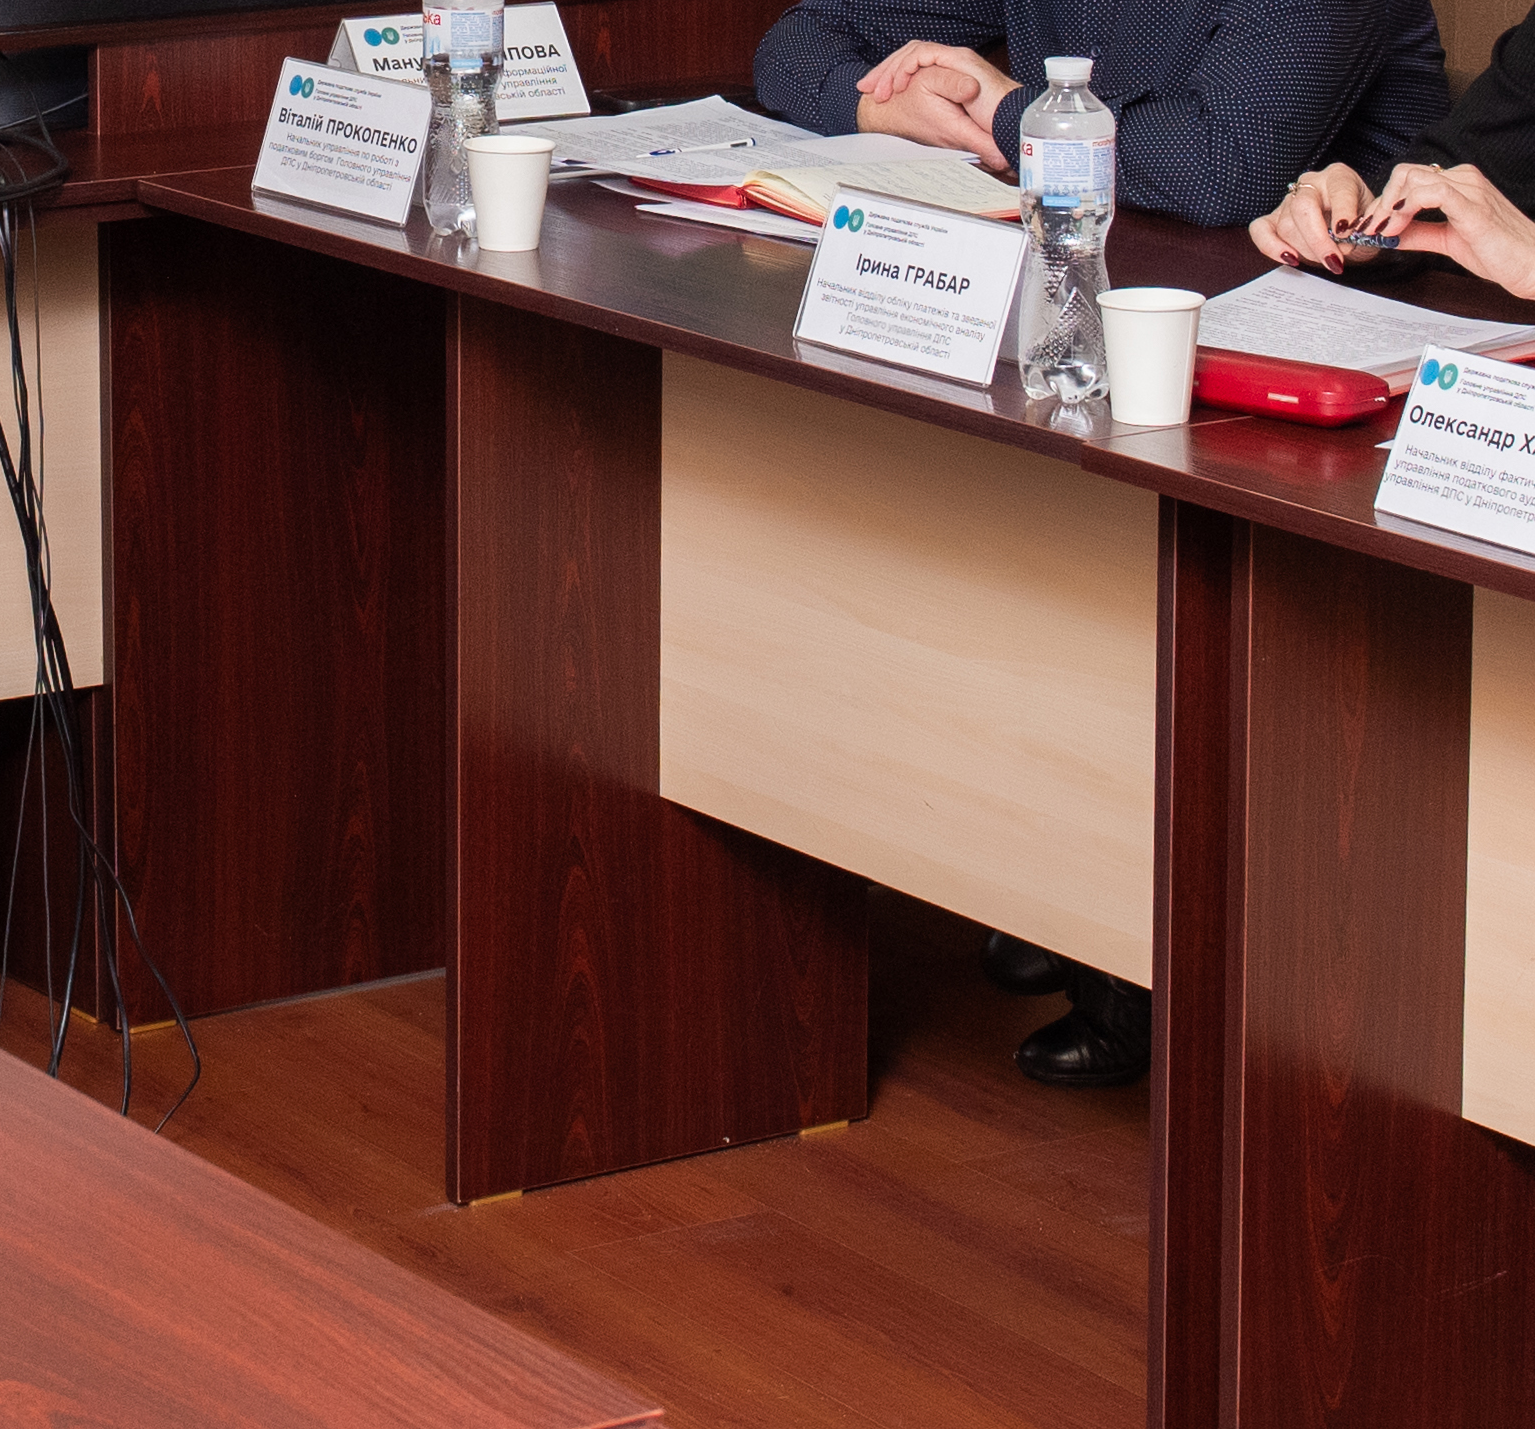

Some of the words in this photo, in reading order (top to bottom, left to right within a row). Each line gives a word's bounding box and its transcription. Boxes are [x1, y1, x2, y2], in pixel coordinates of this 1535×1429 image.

[372, 57, 424, 72] Ману
[503, 44, 561, 61] ПОВА
[503, 64, 568, 78] формаційної
[501, 77, 558, 90] управління
[528, 87, 566, 98] області
[278, 107, 323, 132] Віталій
[325, 118, 417, 153] ПРОКОПЕНКО
[856, 253, 900, 279] Ірина
[904, 264, 970, 295] ГРАБАР
[1409, 405, 1515, 451] Олександр
[1393, 459, 1450, 481] управління
[1451, 475, 1517, 500] податкового
[1405, 444, 1458, 467] Начальник
[1460, 461, 1496, 480] відділу
[1383, 472, 1440, 494] управління
[1440, 486, 1464, 501] ДПС
[1464, 495, 1472, 506] у
